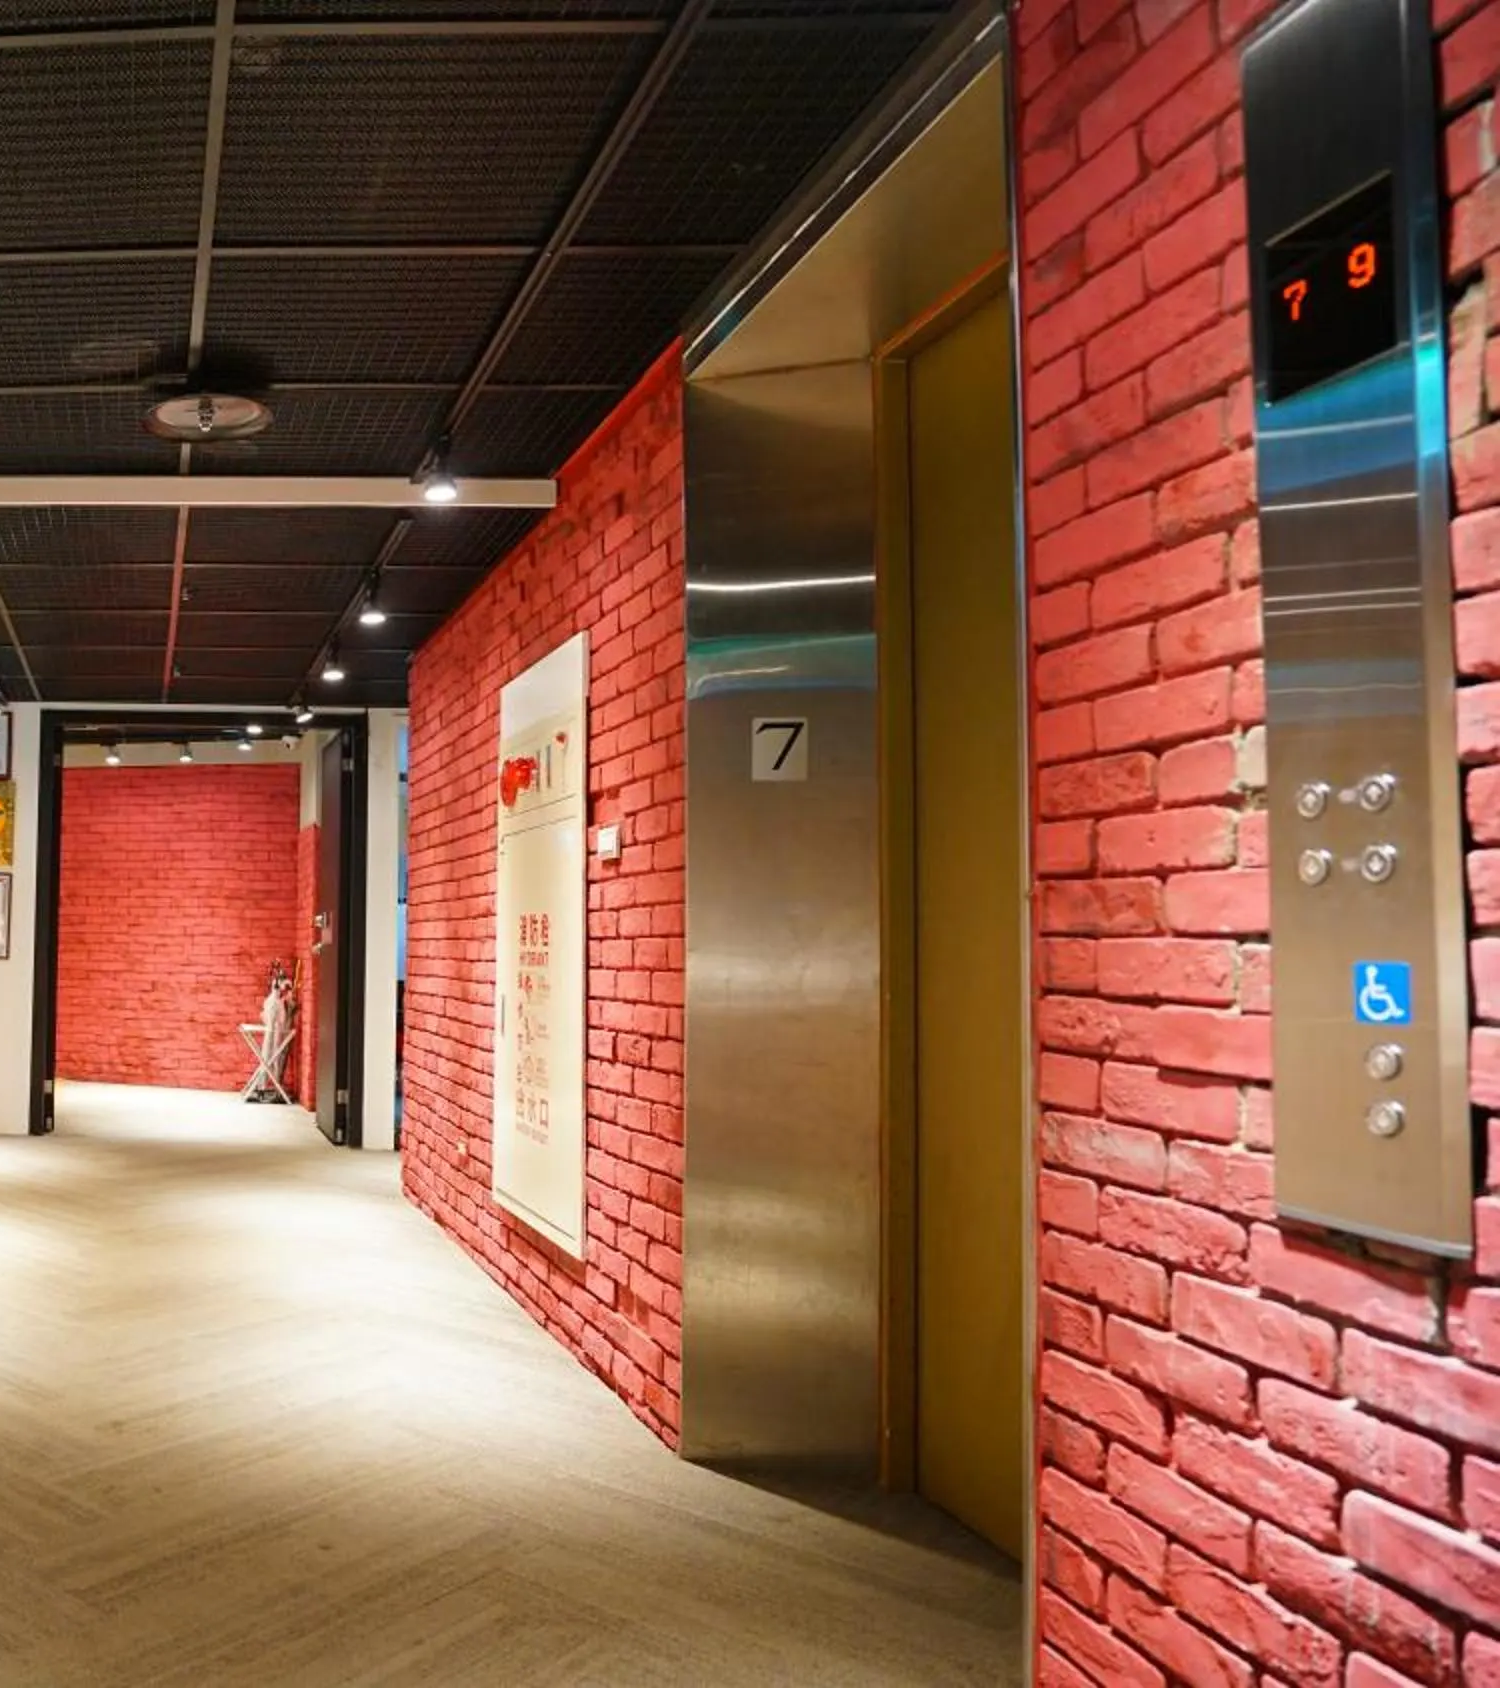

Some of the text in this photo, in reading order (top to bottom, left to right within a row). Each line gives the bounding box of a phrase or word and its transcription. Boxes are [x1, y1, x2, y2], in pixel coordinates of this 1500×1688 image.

[1347, 242, 1376, 289] 9
[1283, 279, 1309, 321] 7
[756, 722, 805, 771] 7
